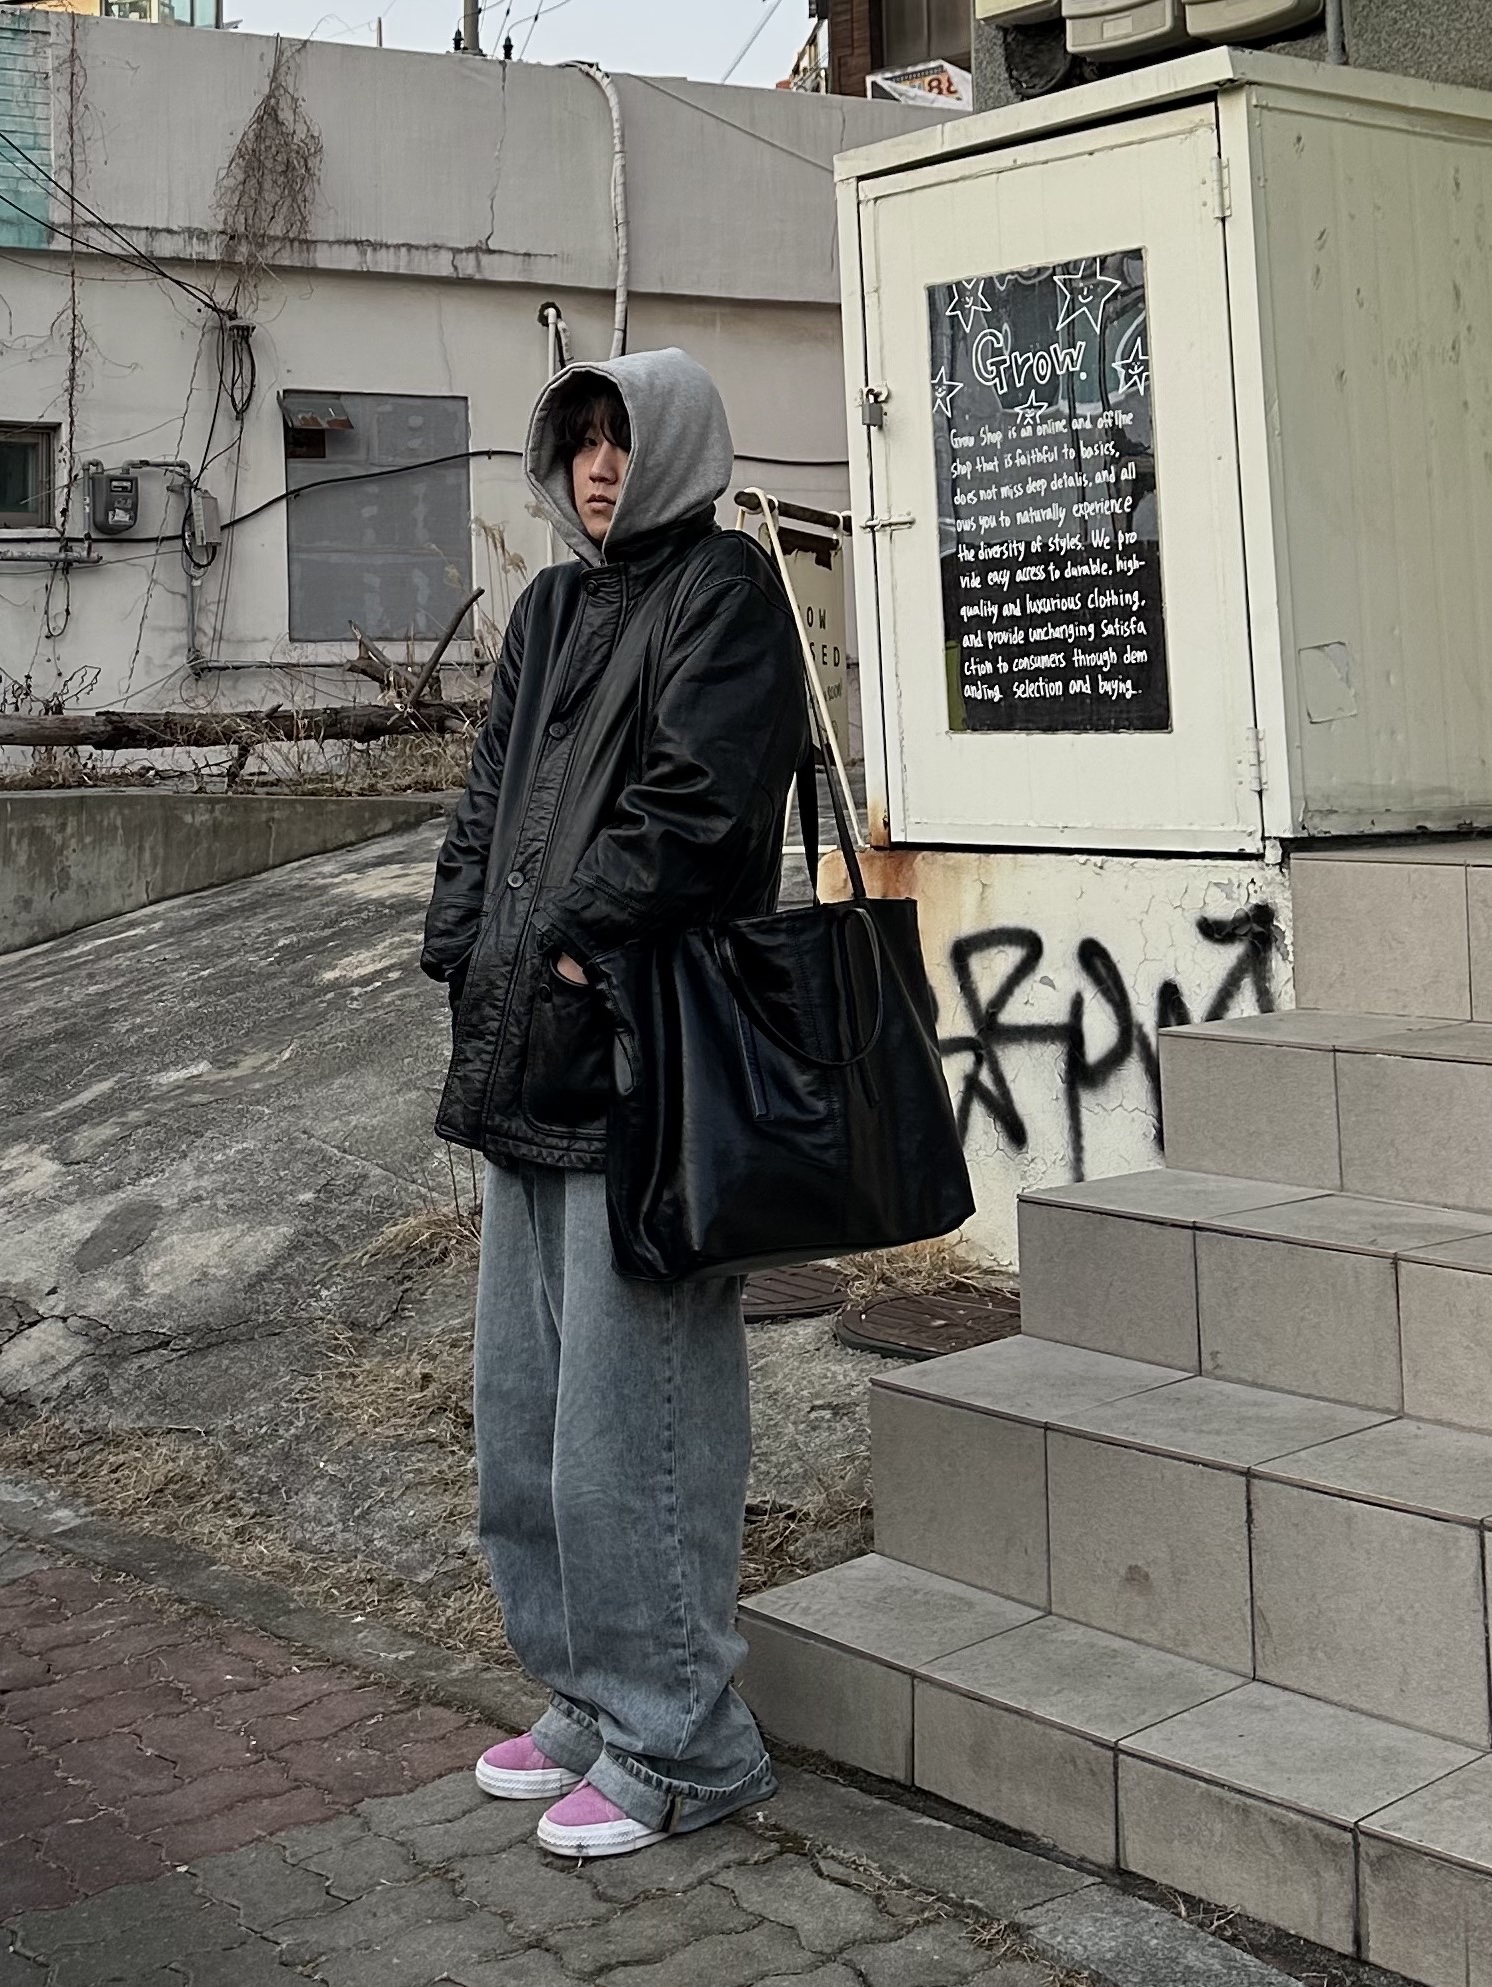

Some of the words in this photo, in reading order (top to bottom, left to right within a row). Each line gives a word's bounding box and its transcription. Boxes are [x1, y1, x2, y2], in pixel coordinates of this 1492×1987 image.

[950, 429, 975, 449] Grow
[1008, 425, 1017, 440] is
[1020, 425, 1033, 438] an
[1036, 418, 1068, 436] online
[1071, 412, 1092, 430] and
[1097, 410, 1133, 430] offline
[976, 456, 999, 473] that
[1004, 453, 1013, 469] is
[1015, 448, 1058, 468] faithful
[1062, 443, 1076, 460] to
[953, 487, 978, 505] does
[979, 484, 998, 501] not
[1000, 482, 1024, 500] miss
[1026, 476, 1048, 496] deep
[1094, 465, 1116, 483] and
[1120, 461, 1136, 480] all
[956, 516, 977, 532] ows
[979, 515, 997, 535] you
[999, 510, 1011, 528] to
[1016, 502, 1066, 528] naturally
[1072, 496, 1132, 520] experience
[957, 543, 976, 562] the
[977, 540, 1026, 561] diversity
[1031, 535, 1042, 553] of
[1091, 527, 1110, 550] We
[1118, 530, 1137, 551] pro
[960, 572, 982, 589] vide
[1016, 564, 1046, 582] access
[1048, 561, 1060, 581] to
[960, 599, 999, 625] quality
[1002, 598, 1021, 616] and
[1026, 592, 1082, 614] luxurious
[962, 629, 984, 647] and
[987, 626, 1025, 649] provide
[1028, 621, 1095, 643] unchanging
[964, 656, 993, 676] ction
[996, 655, 1009, 674] to
[1012, 652, 1066, 672] consumers
[1072, 646, 1117, 671] through
[1123, 644, 1147, 664] dem
[1069, 674, 1091, 694] and
